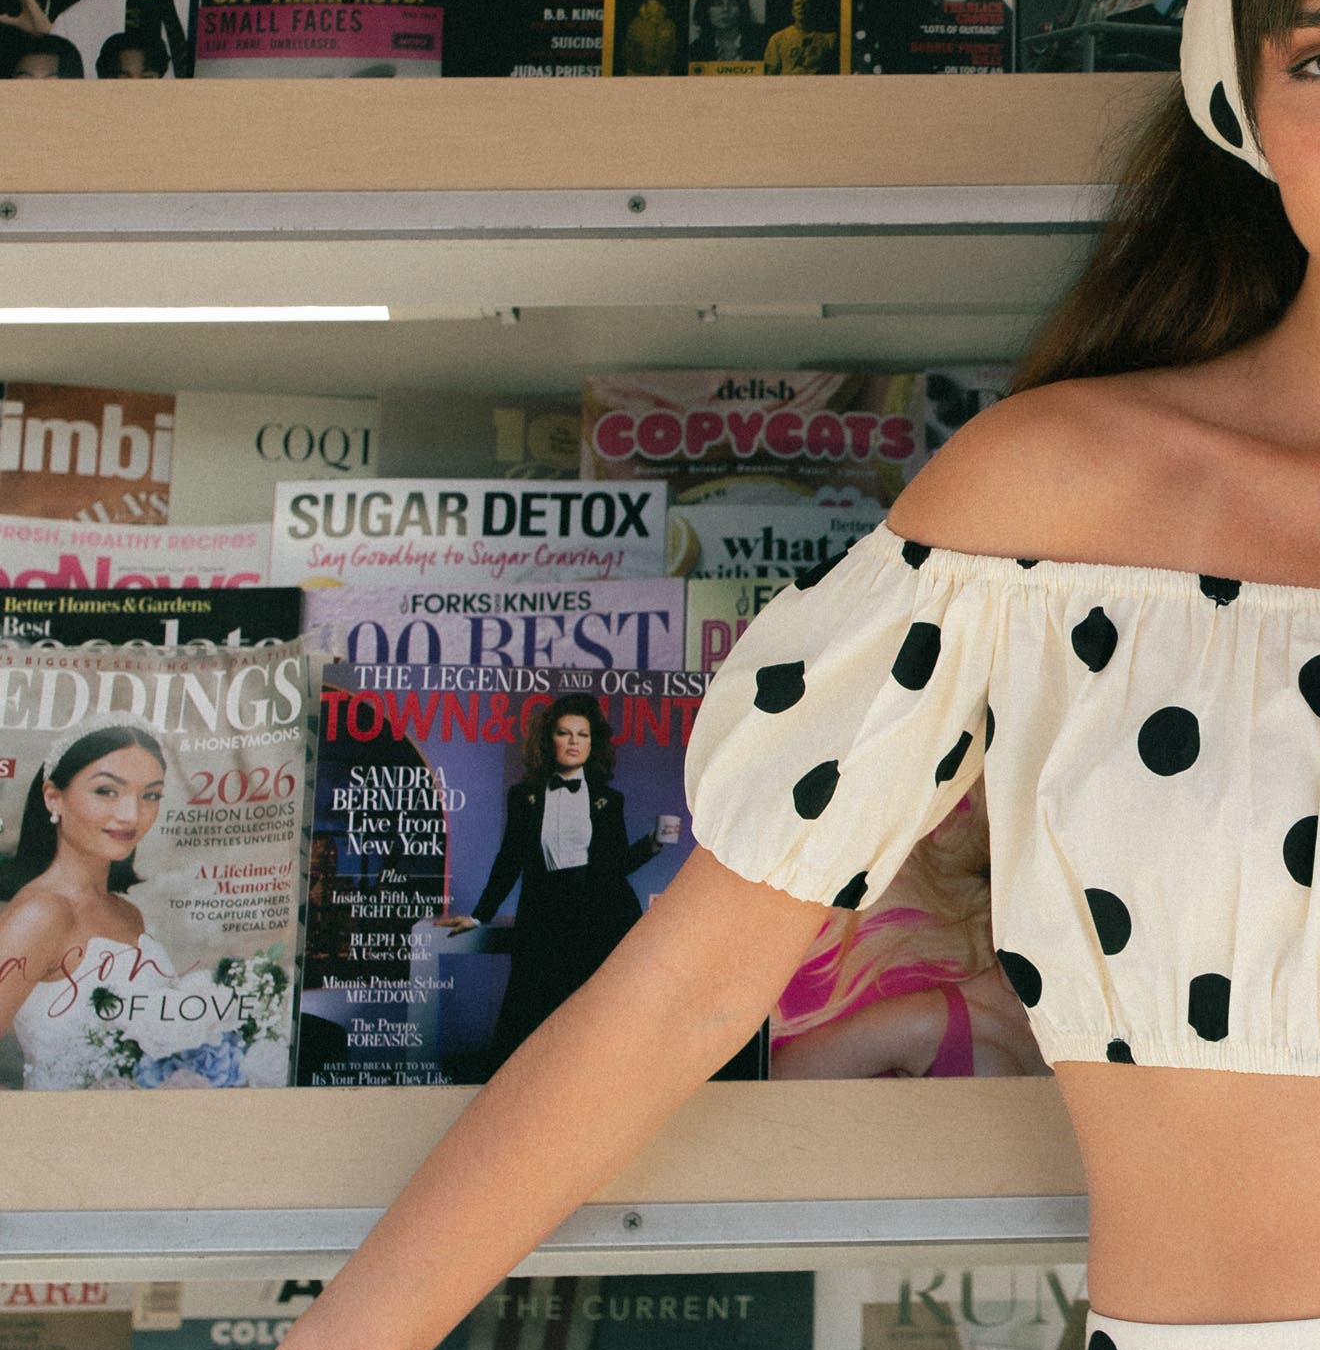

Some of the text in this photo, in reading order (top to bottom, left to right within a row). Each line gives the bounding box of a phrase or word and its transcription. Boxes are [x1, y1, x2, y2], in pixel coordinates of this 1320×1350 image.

[204, 9, 363, 36] SMALL FACES
[714, 378, 797, 403] delish
[594, 409, 919, 462] COPYCATS
[288, 491, 652, 539] SUGAR DETOX
[722, 525, 829, 562] what
[349, 544, 531, 579] Goodbye Sugar
[4, 596, 212, 614] Better Homes Gardens
[411, 590, 592, 614] FORKS KNIVES
[3, 615, 50, 637] Best
[354, 665, 653, 696] THE LEGENDS AND OGs
[194, 727, 300, 752] HONEYMOONS
[187, 759, 297, 807] 2026
[349, 766, 448, 789] SANDRA
[332, 788, 467, 813] BERNHARD
[165, 801, 296, 824] FASHION LOOKS
[346, 810, 448, 835] Live from
[179, 818, 295, 836] LATEST COLLECTIONS
[175, 830, 295, 849] AND STYLES UNVEILED
[346, 833, 445, 857] New York
[211, 863, 276, 879] Lifetime
[380, 869, 409, 886] Plus
[214, 879, 292, 896] Memories
[331, 891, 455, 906] Inside Fifth Avenue
[169, 894, 291, 910] TOP PHOTOGRAPHERS
[350, 904, 435, 920] FIGHT CLUB
[190, 907, 290, 921] TO CAPTURE YOUR
[222, 919, 289, 933] SPECIAL DAY
[350, 933, 396, 948] BLEPH
[396, 948, 433, 962] Guide
[369, 974, 455, 992] Private School
[94, 994, 259, 1022] OF LOVE
[345, 990, 428, 1005] MELTDOWN
[351, 1019, 420, 1037] The Preppy
[346, 1033, 424, 1048] FORENSICS
[500, 1294, 754, 1323] THE CURRENT
